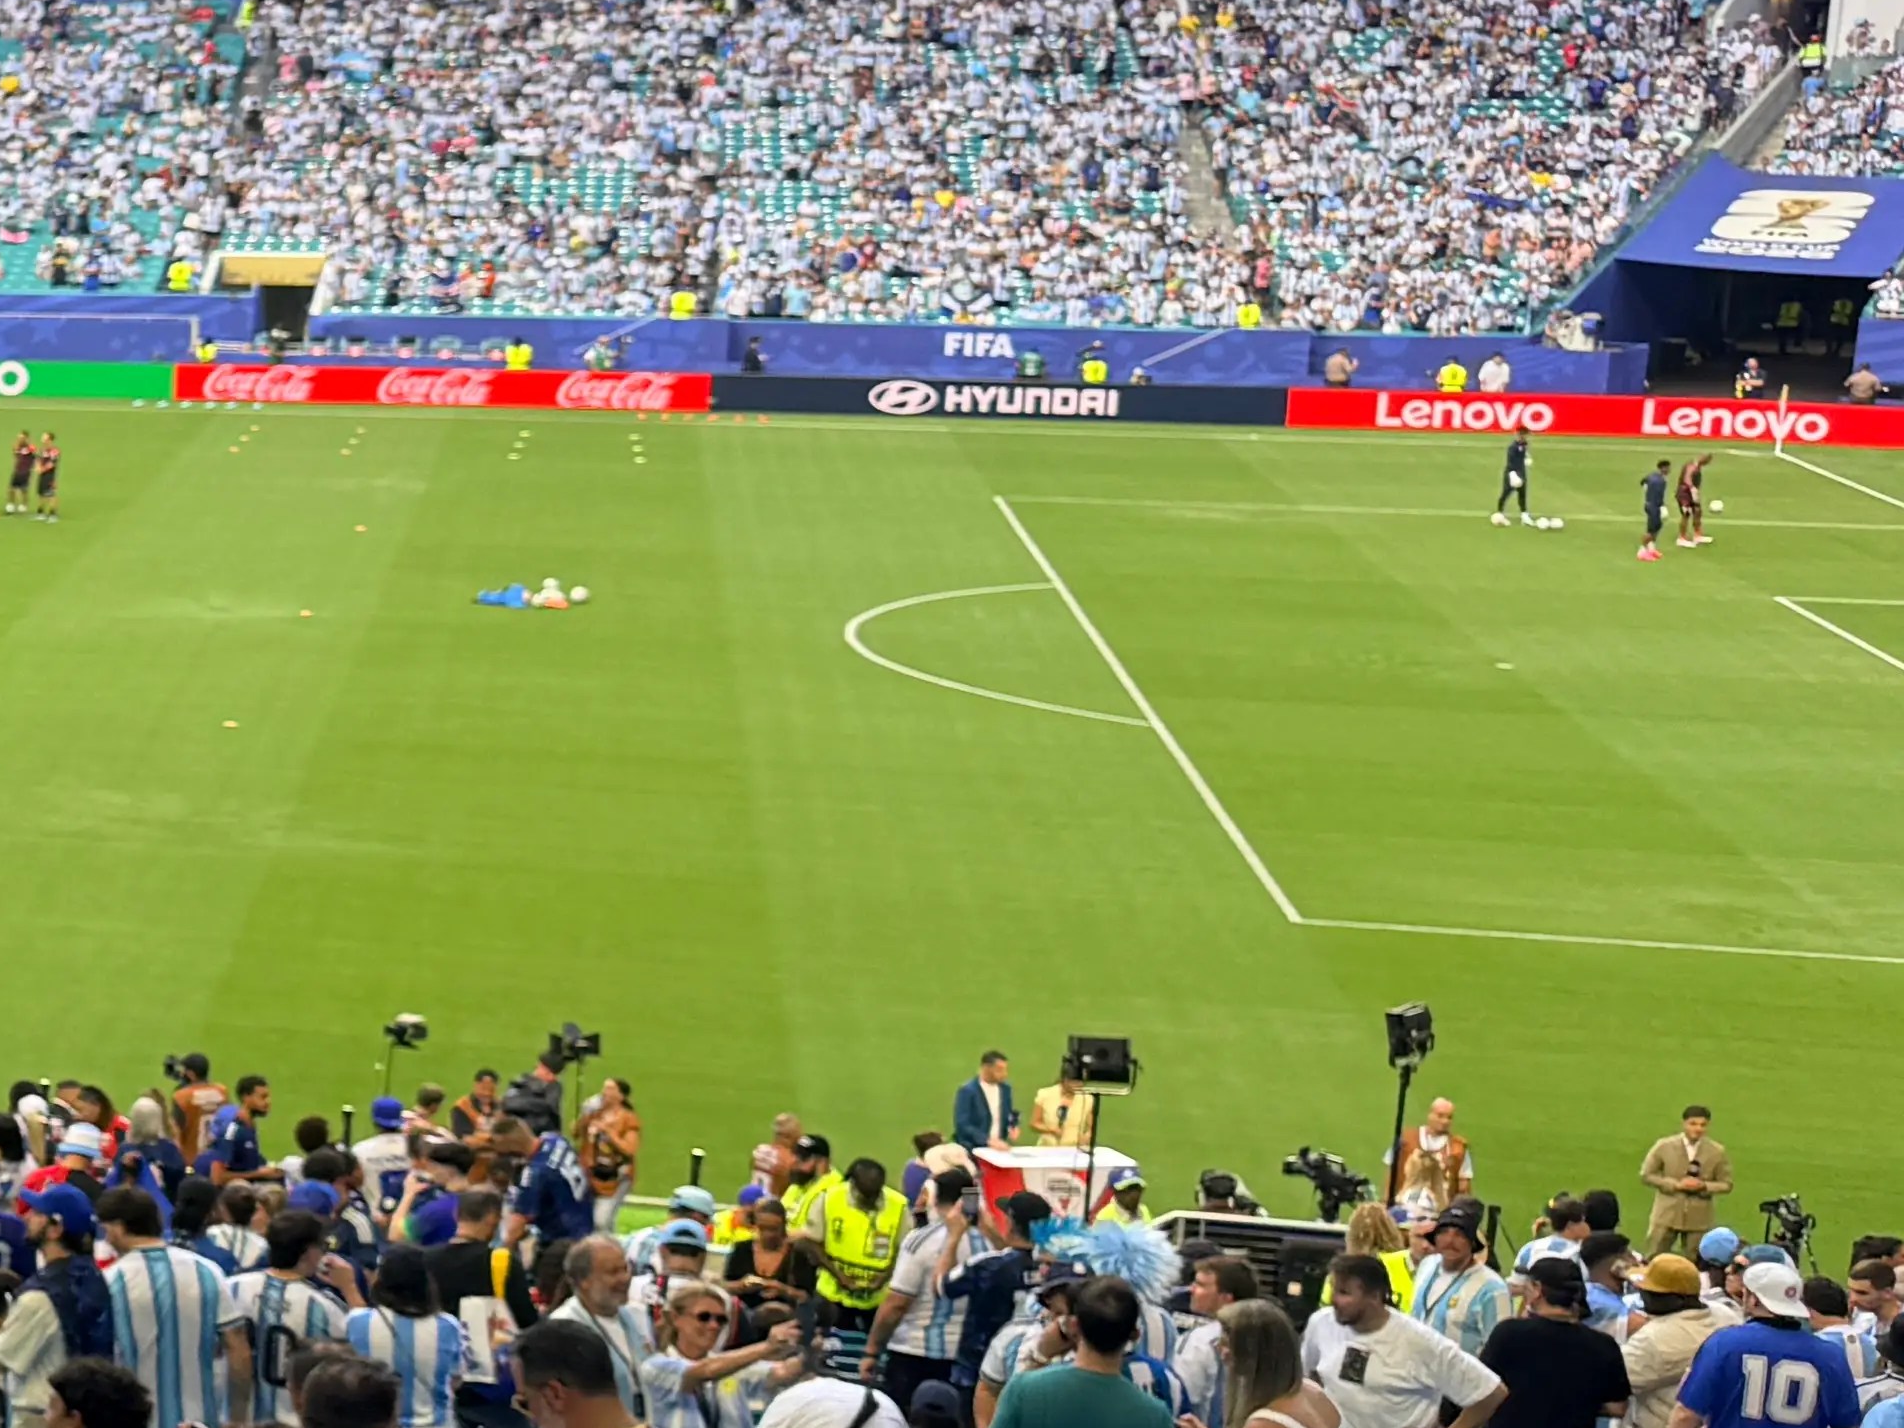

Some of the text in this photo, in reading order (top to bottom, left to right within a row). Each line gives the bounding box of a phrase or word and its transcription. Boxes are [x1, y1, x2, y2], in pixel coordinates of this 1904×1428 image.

[944, 332, 1015, 358] FIFA
[202, 362, 320, 402] Coca-Cola
[378, 366, 493, 406] Coca-Cola
[555, 370, 676, 411] Coca-Cola
[944, 385, 1118, 418] HYUNDAI
[1376, 390, 1553, 432] Lenovo
[1642, 397, 1830, 441] Lenovo
[1740, 1354, 1821, 1427] 10
